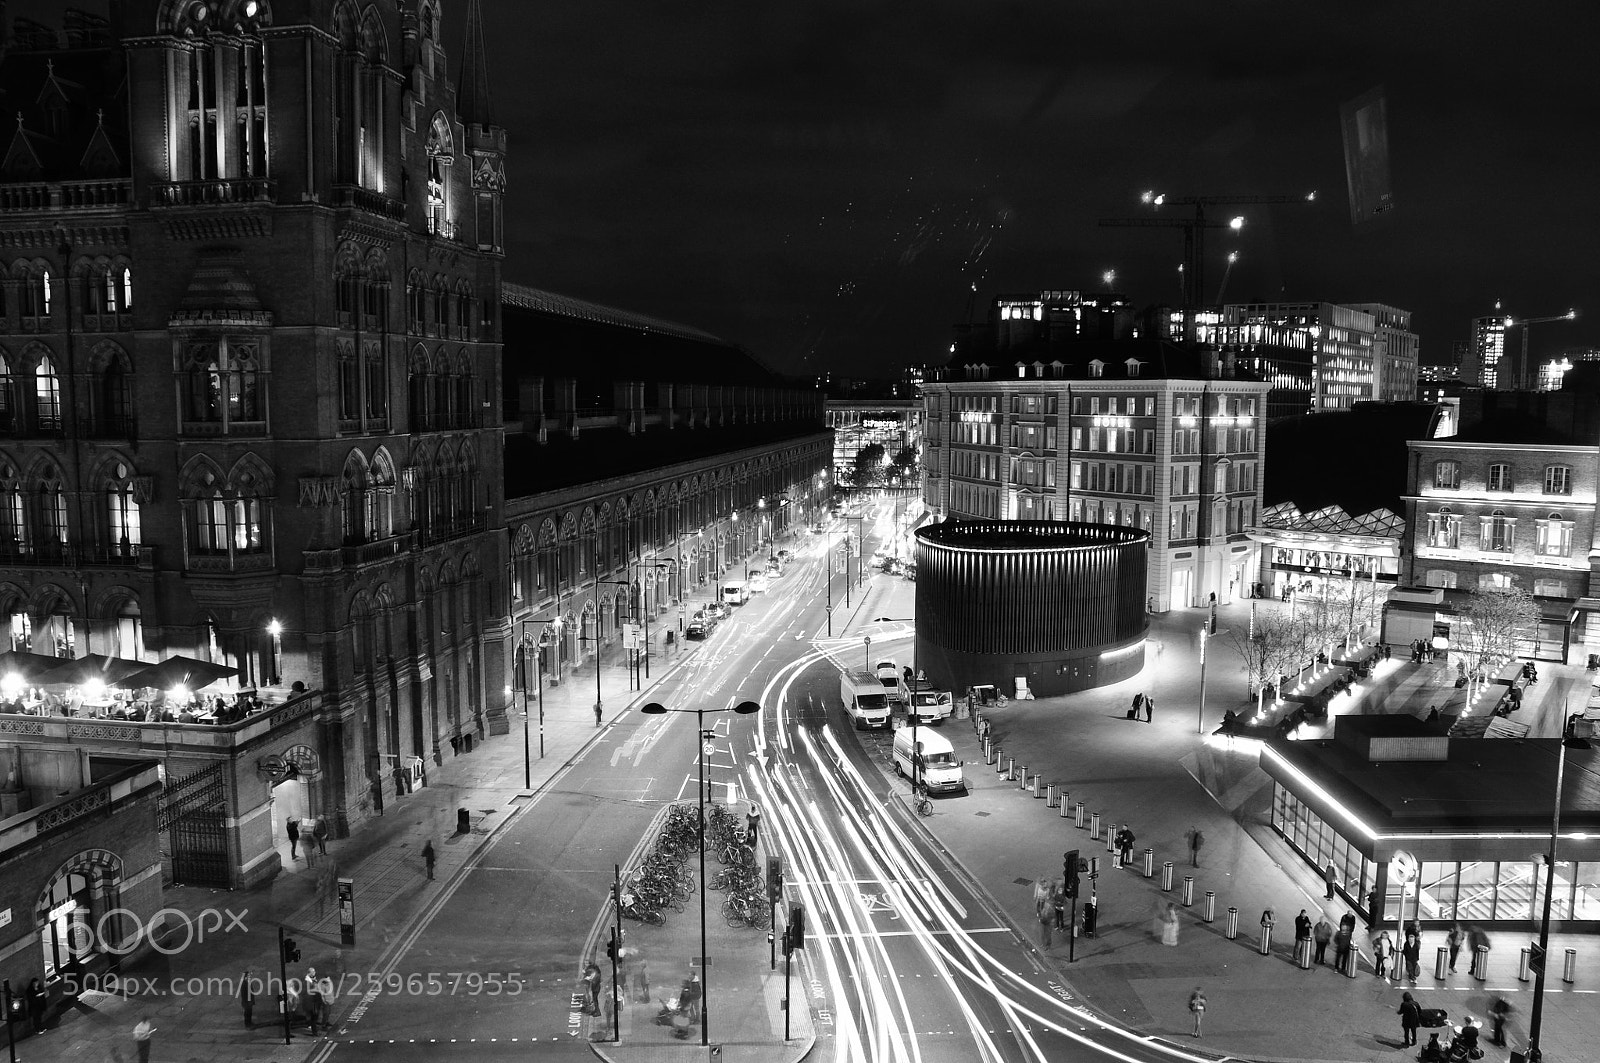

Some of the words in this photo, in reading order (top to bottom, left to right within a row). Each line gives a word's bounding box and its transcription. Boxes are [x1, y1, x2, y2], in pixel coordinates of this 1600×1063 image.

[570, 992, 584, 1008] LEFT
[568, 1011, 582, 1028] LOOK
[817, 1009, 833, 1026] LEFT
